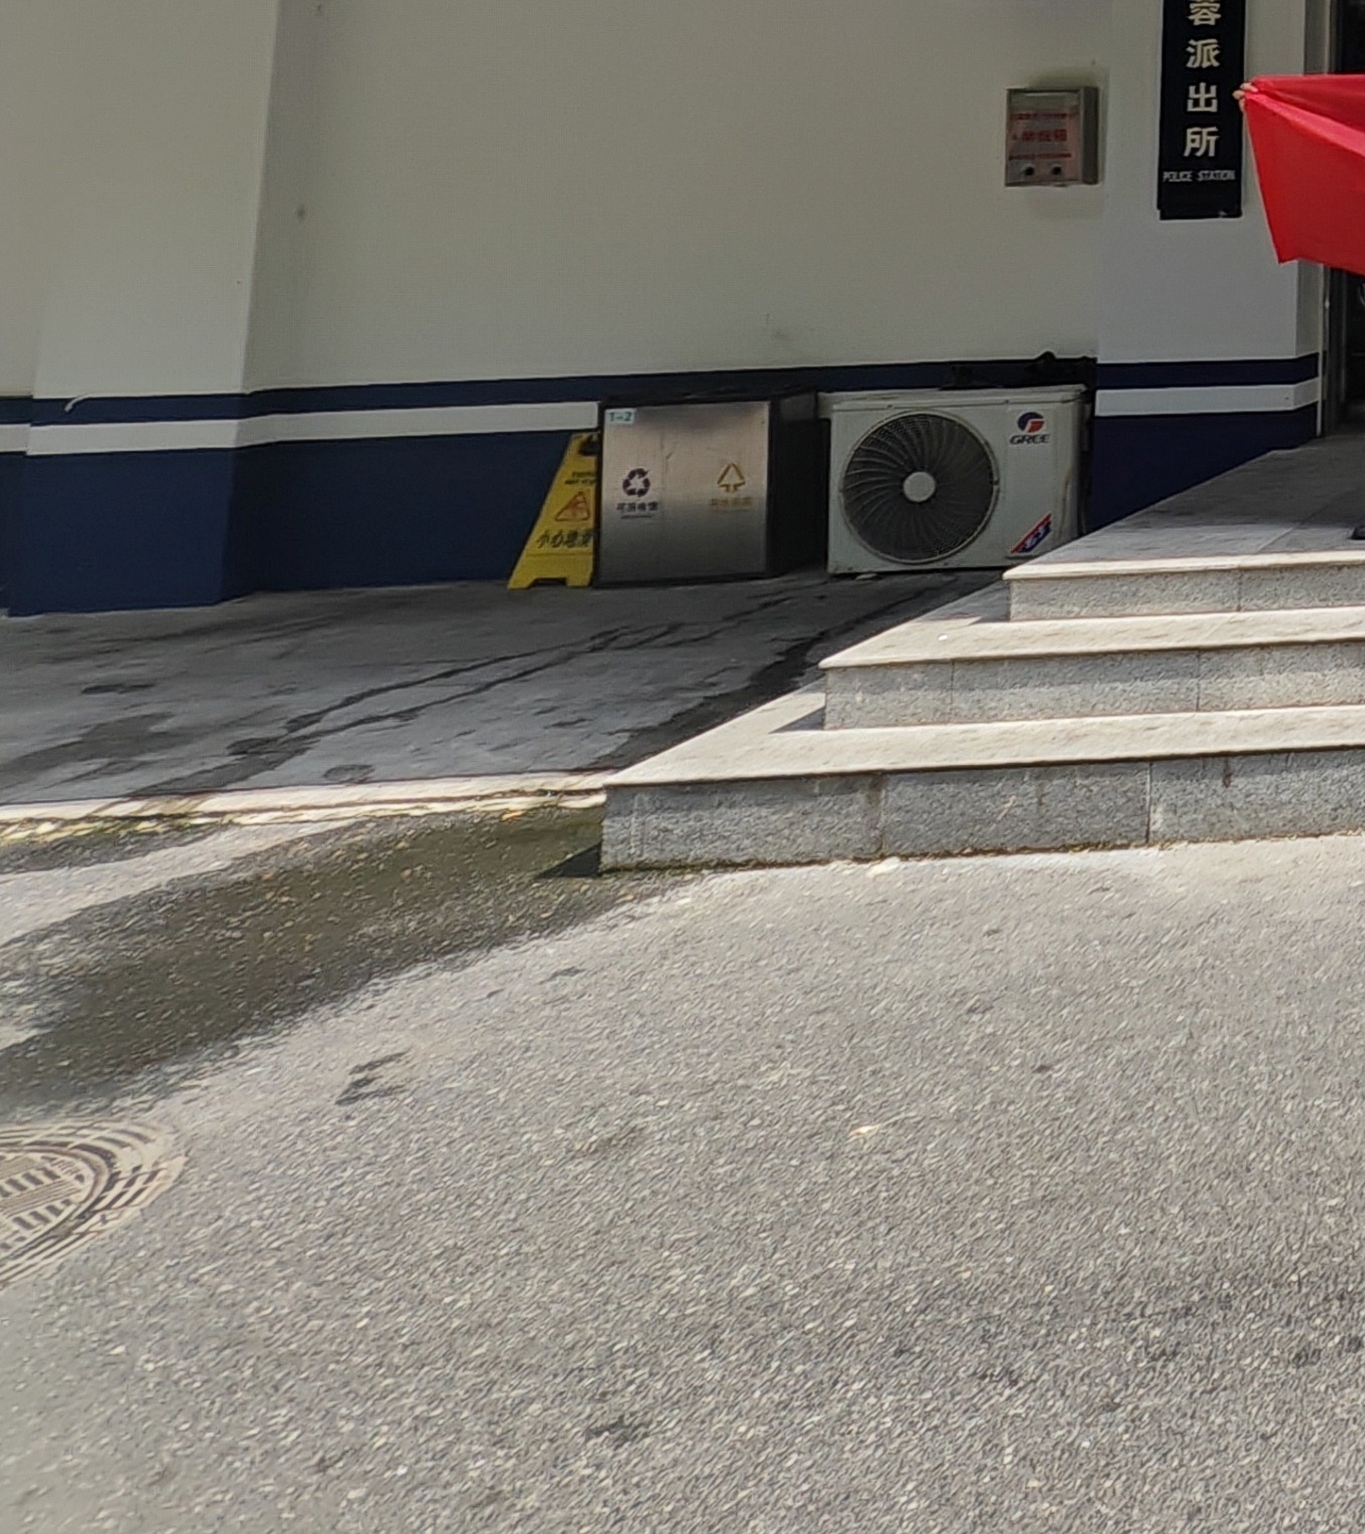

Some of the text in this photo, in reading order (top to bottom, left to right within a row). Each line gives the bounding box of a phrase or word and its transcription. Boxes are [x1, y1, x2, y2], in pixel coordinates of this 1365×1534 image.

[1163, 169, 1235, 182] POLICE STATION
[1010, 434, 1050, 445] GREE
